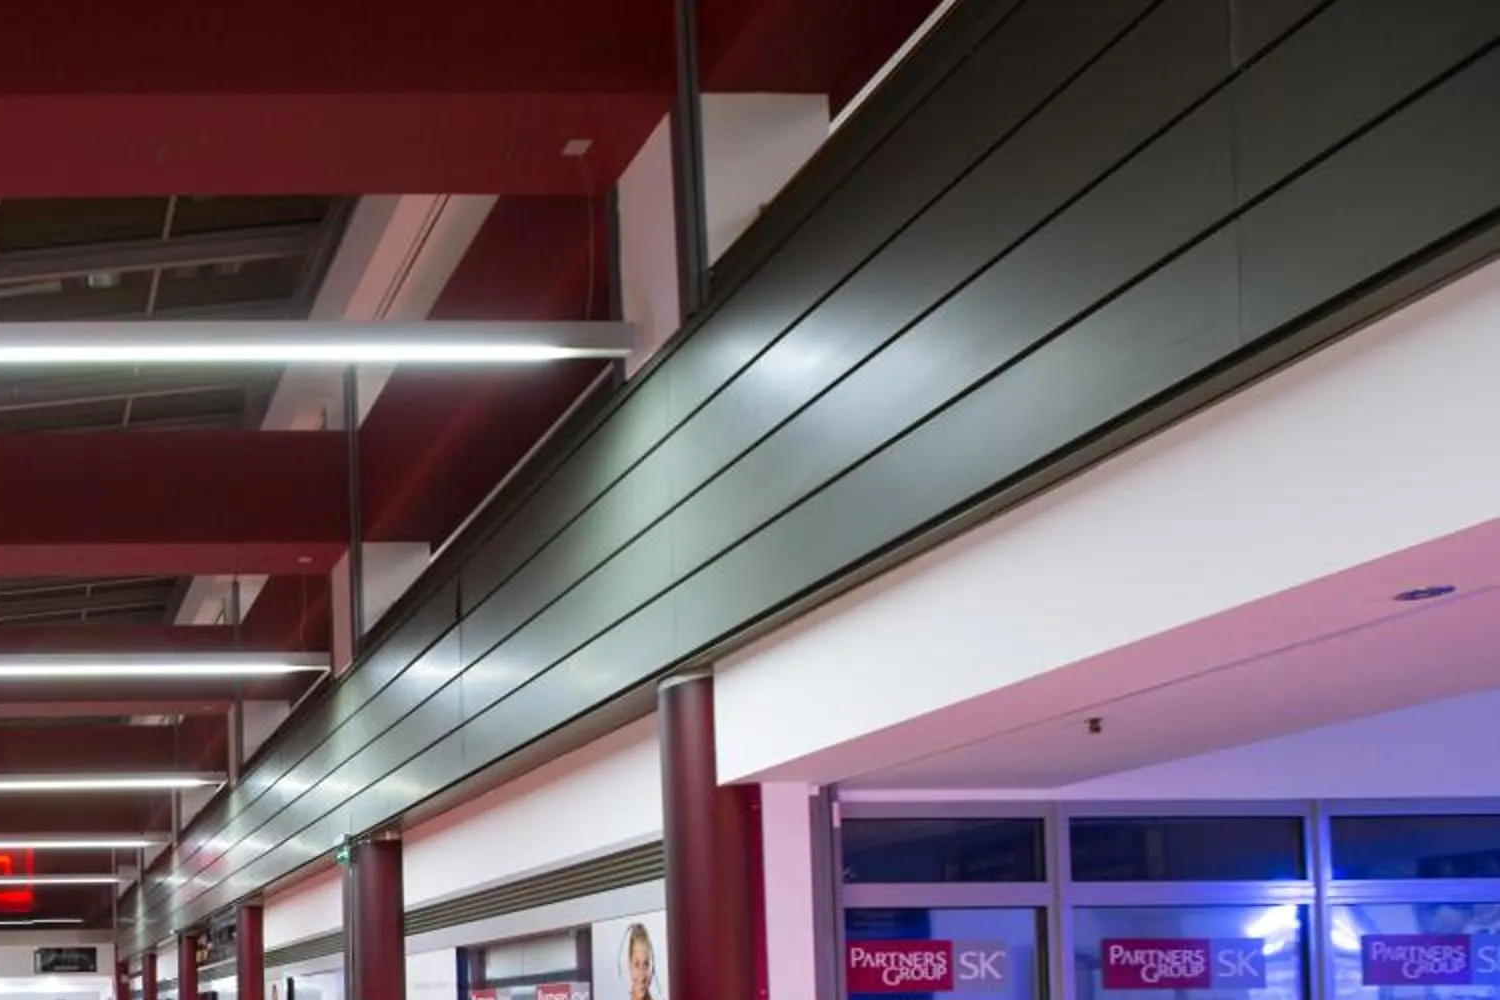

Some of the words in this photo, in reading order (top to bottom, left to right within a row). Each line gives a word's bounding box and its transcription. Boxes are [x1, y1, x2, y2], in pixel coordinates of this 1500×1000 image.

[850, 947, 948, 968] PARTNERS
[1109, 945, 1206, 965] PARTNERS
[1371, 941, 1467, 961] PARTNERS
[959, 951, 1003, 979] SK
[1141, 963, 1206, 983] GROUP
[1217, 950, 1259, 977] SK
[1402, 960, 1467, 979] GROUP
[882, 966, 947, 986] GROUP
